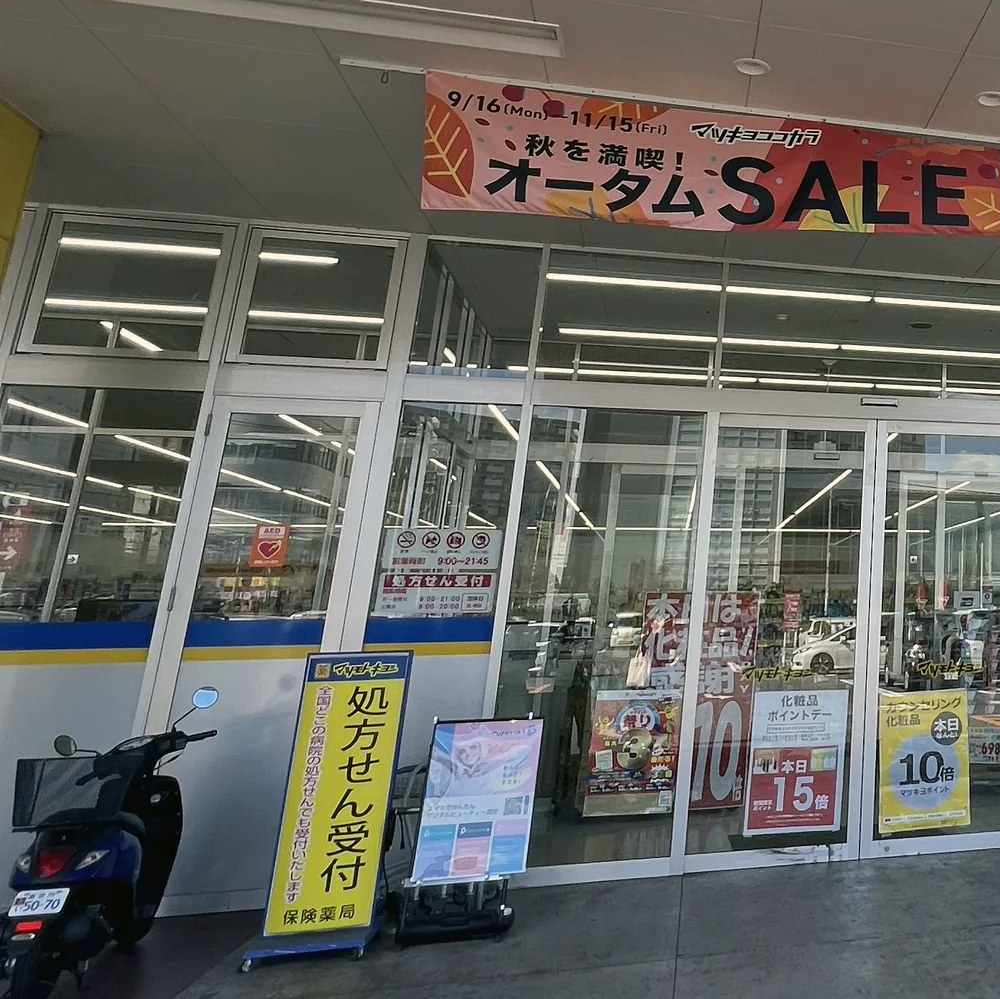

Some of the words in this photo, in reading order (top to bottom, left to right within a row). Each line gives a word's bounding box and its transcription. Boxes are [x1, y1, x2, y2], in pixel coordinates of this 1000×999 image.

[690, 123, 821, 147] マツキヨココカラ
[484, 157, 706, 219] オータム
[717, 156, 970, 227] SALE
[392, 575, 484, 587] 処方せん受付
[334, 661, 398, 677] マツモトキヨシ
[780, 694, 818, 708] 化粧品
[886, 696, 962, 713] カウンセリング
[768, 708, 832, 721] ポイントデー
[886, 713, 921, 727] 化粧品
[933, 717, 959, 732] 本日
[781, 759, 808, 774] 本日
[899, 750, 955, 786] 10倍
[320, 685, 389, 893] 処方せん受付
[900, 786, 950, 797] マツキヨポイント
[283, 904, 355, 925] 保険薬局
